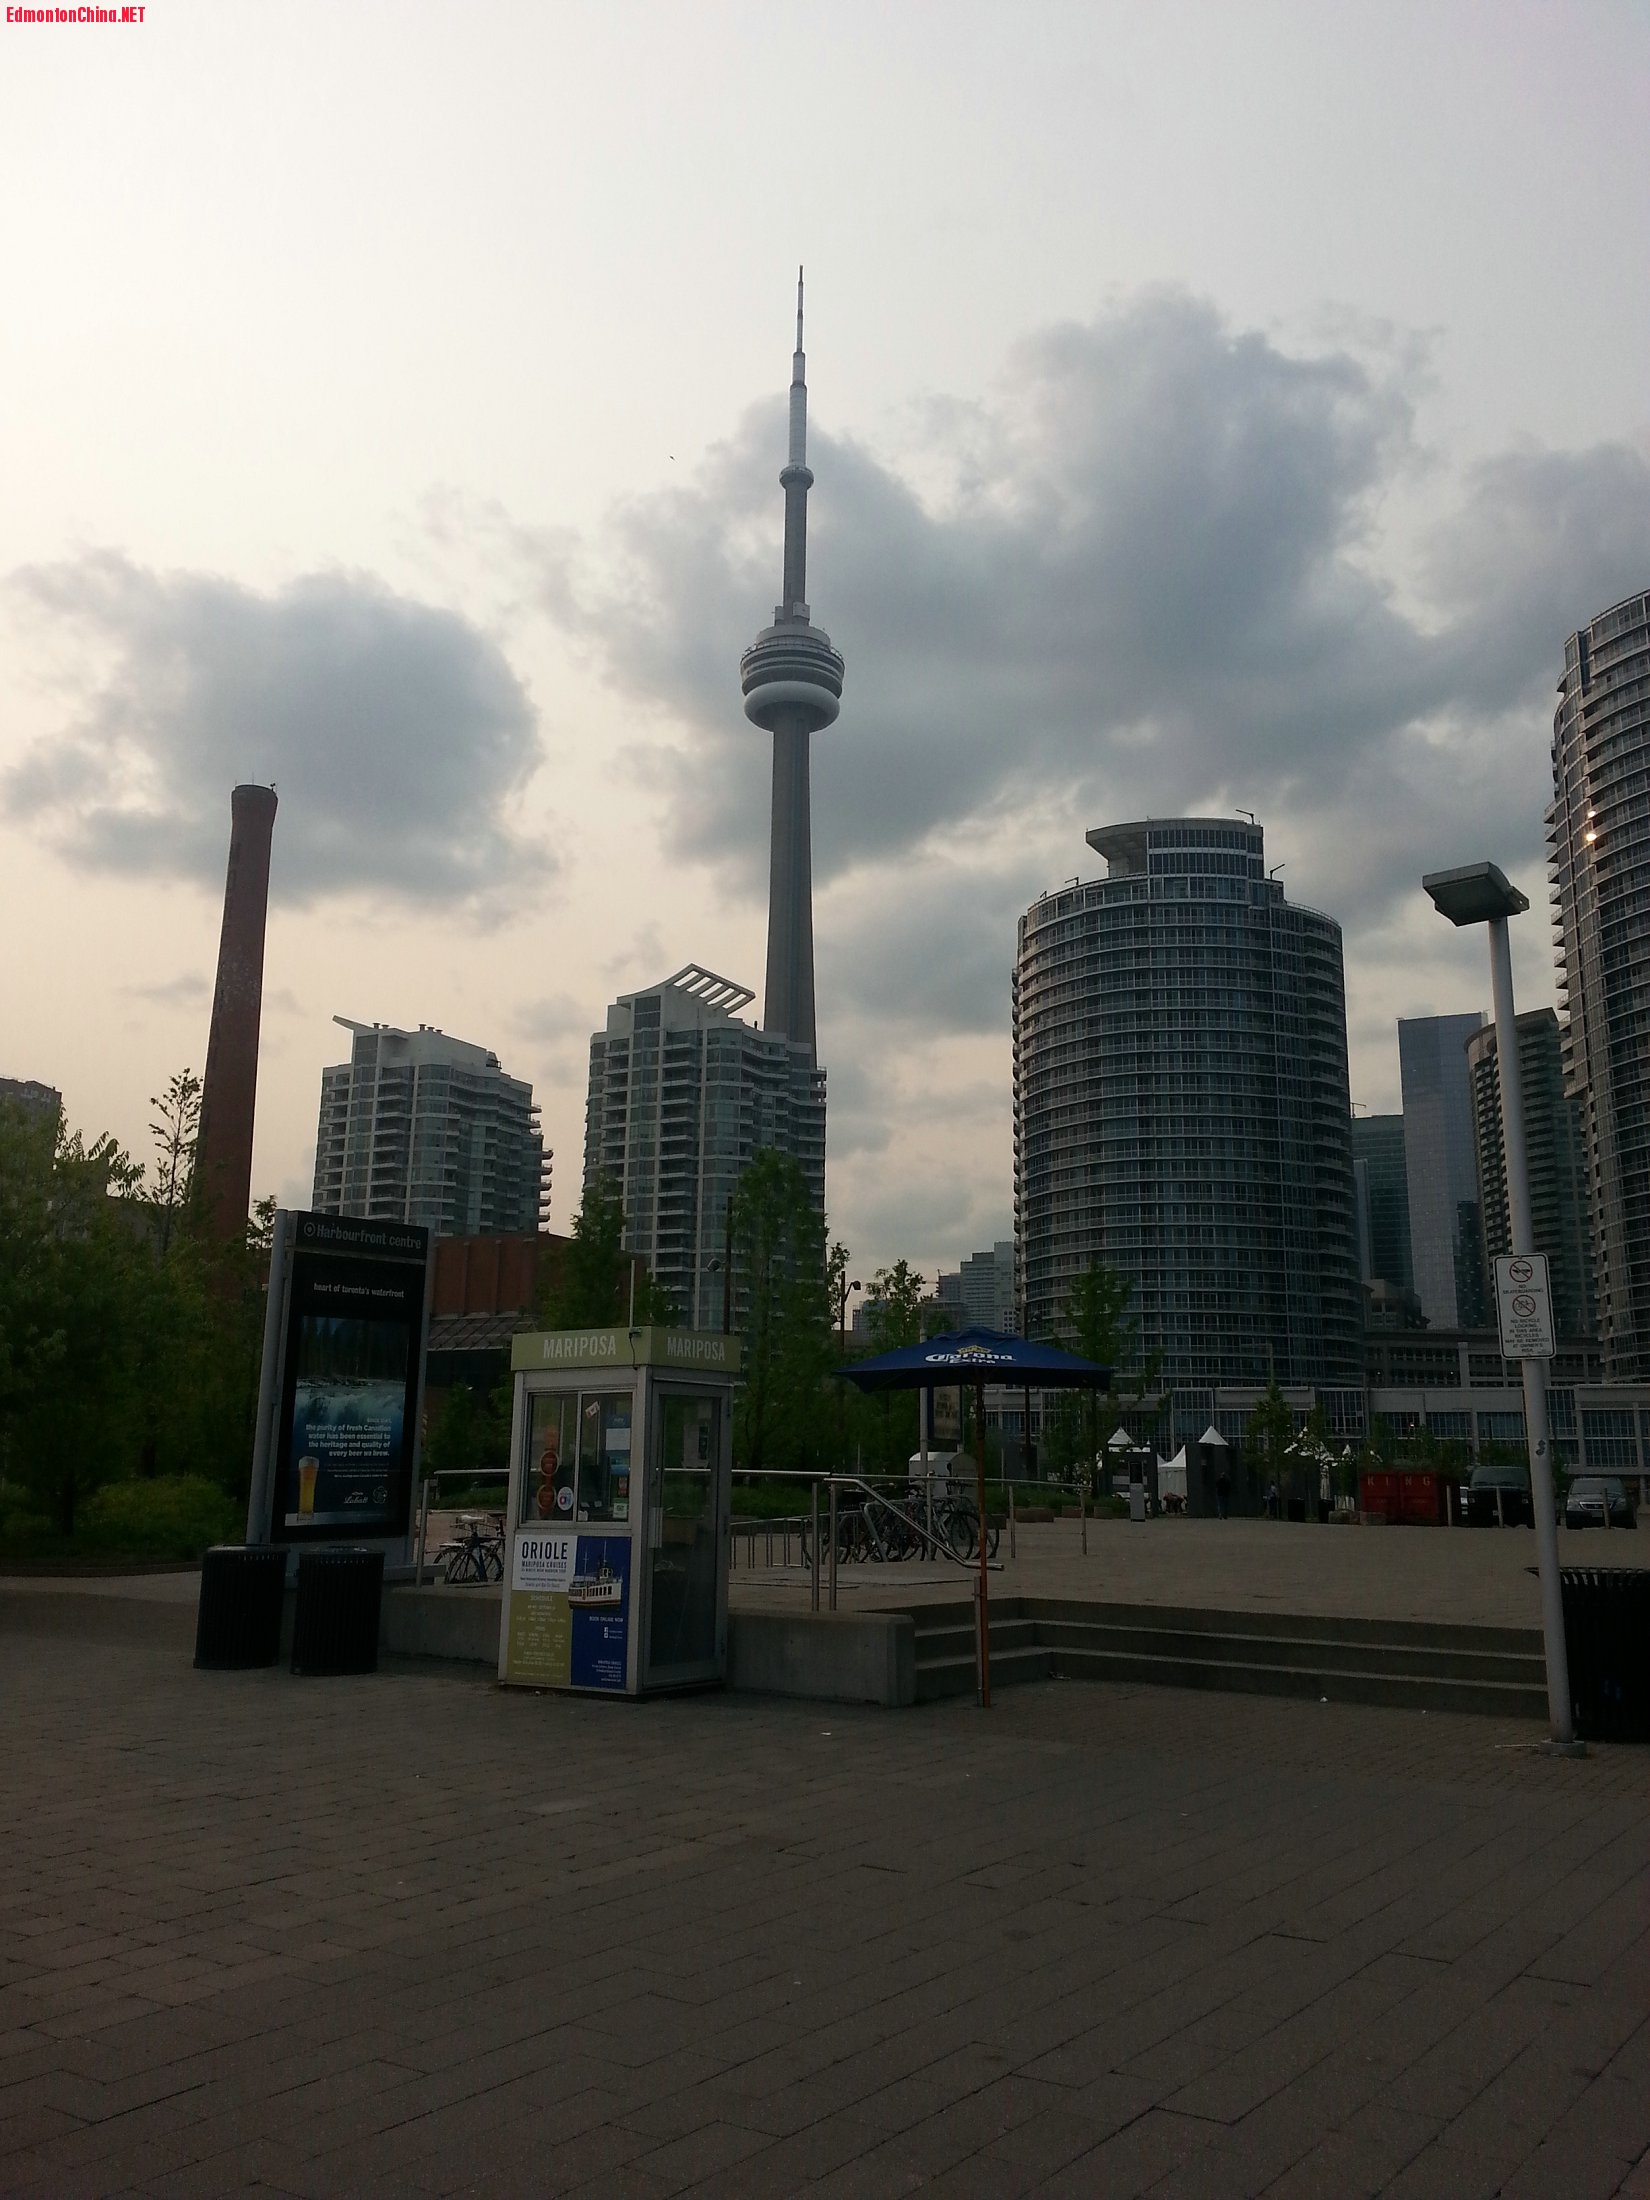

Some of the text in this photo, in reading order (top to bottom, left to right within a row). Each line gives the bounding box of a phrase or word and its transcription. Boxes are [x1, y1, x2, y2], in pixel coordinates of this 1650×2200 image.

[316, 1223, 421, 1250] Harbourfront centre
[314, 1282, 405, 1298] heart of toronto's waterfront
[543, 1335, 617, 1359] MARIPOSA
[667, 1336, 726, 1361] MARIPOSA
[925, 1353, 1016, 1363] Corona
[521, 1541, 568, 1560] ORIOLE
[522, 1560, 545, 1568] MARIPOSA
